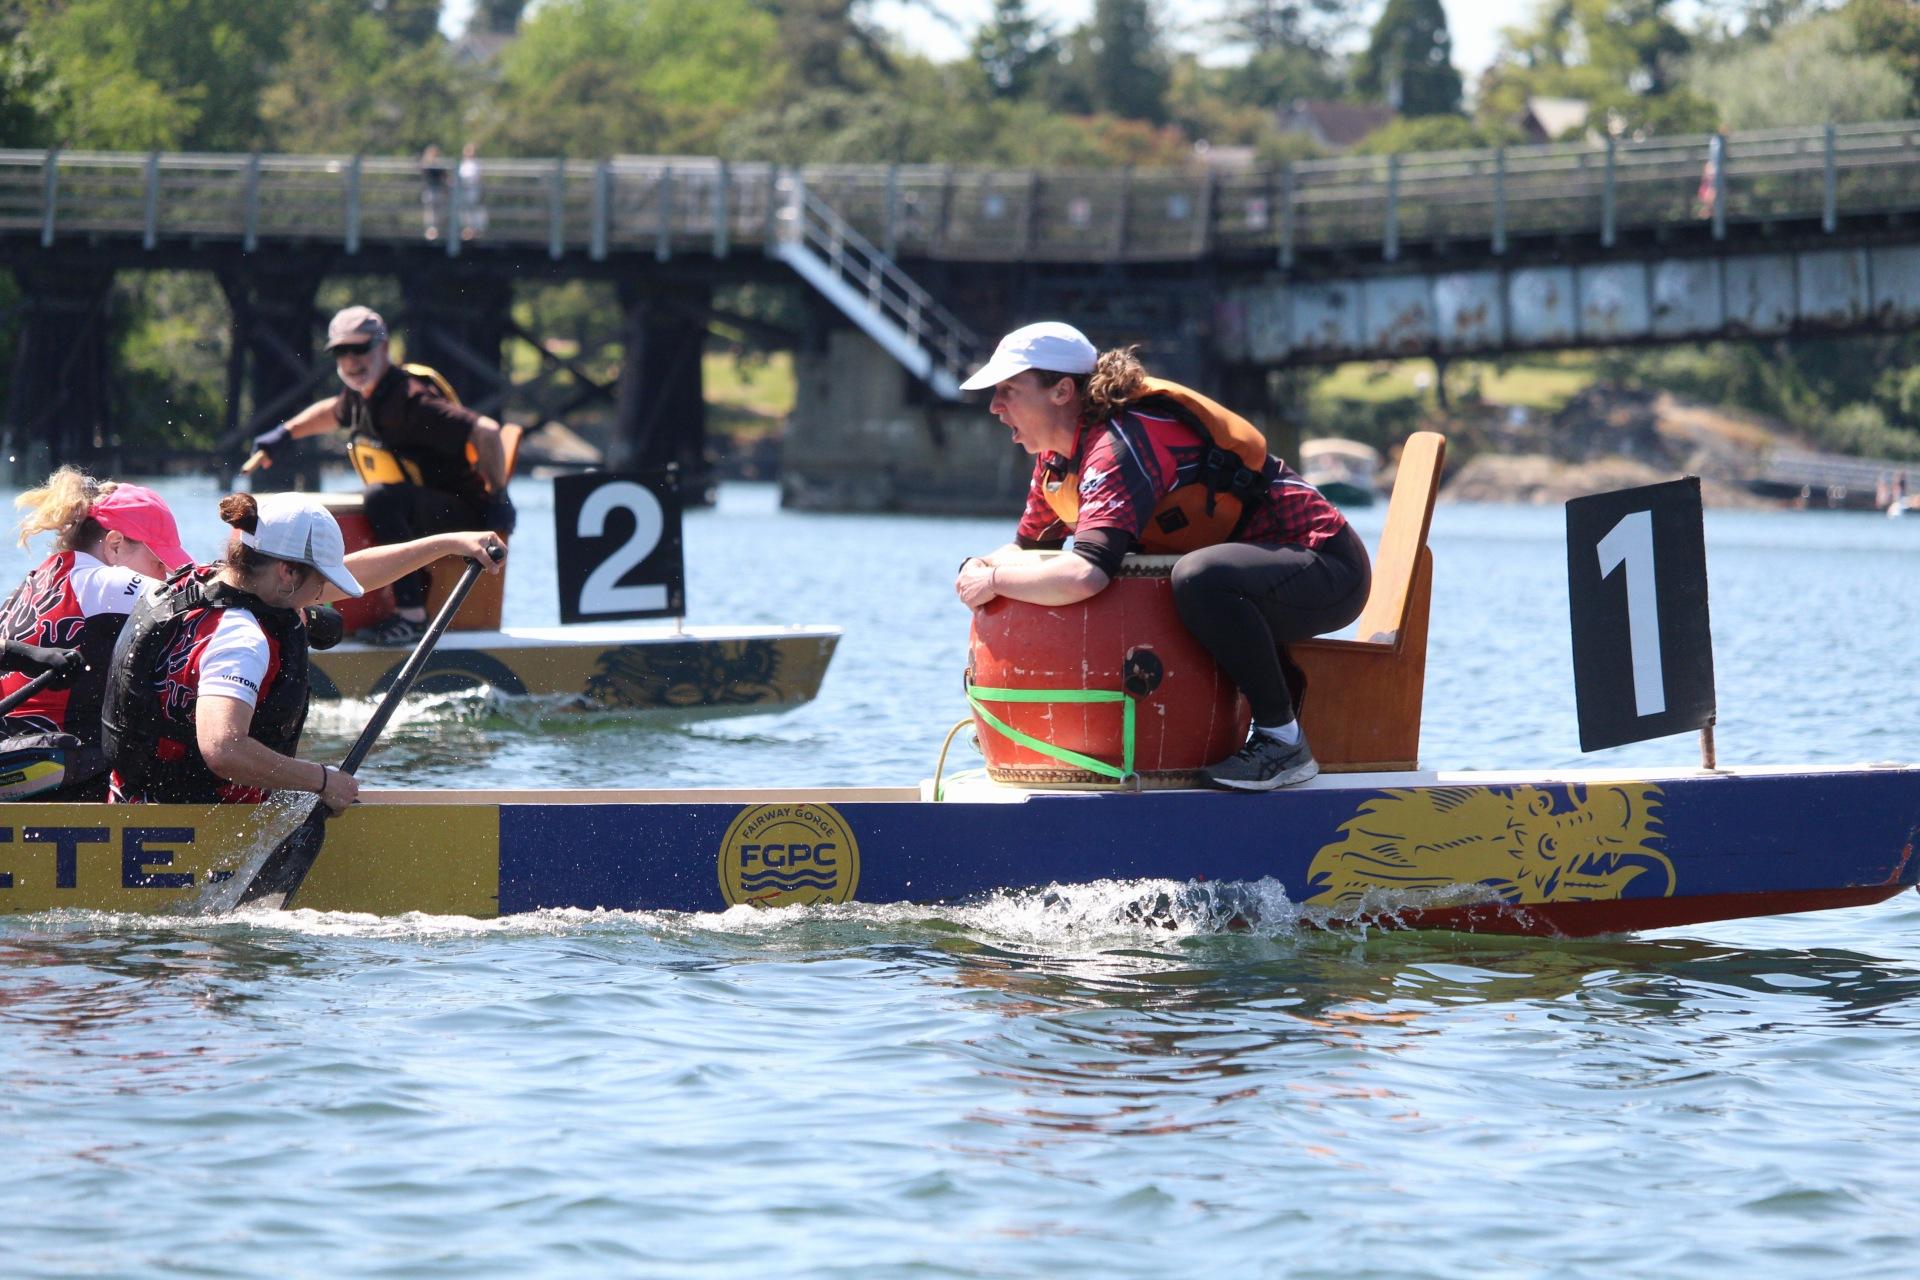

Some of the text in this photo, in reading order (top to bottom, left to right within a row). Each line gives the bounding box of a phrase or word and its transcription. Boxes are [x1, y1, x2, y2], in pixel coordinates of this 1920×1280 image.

[577, 480, 669, 614] 2
[1596, 509, 1666, 717] 1
[741, 843, 837, 867] FGPC
[742, 808, 835, 839] FAIRWAY GORGE
